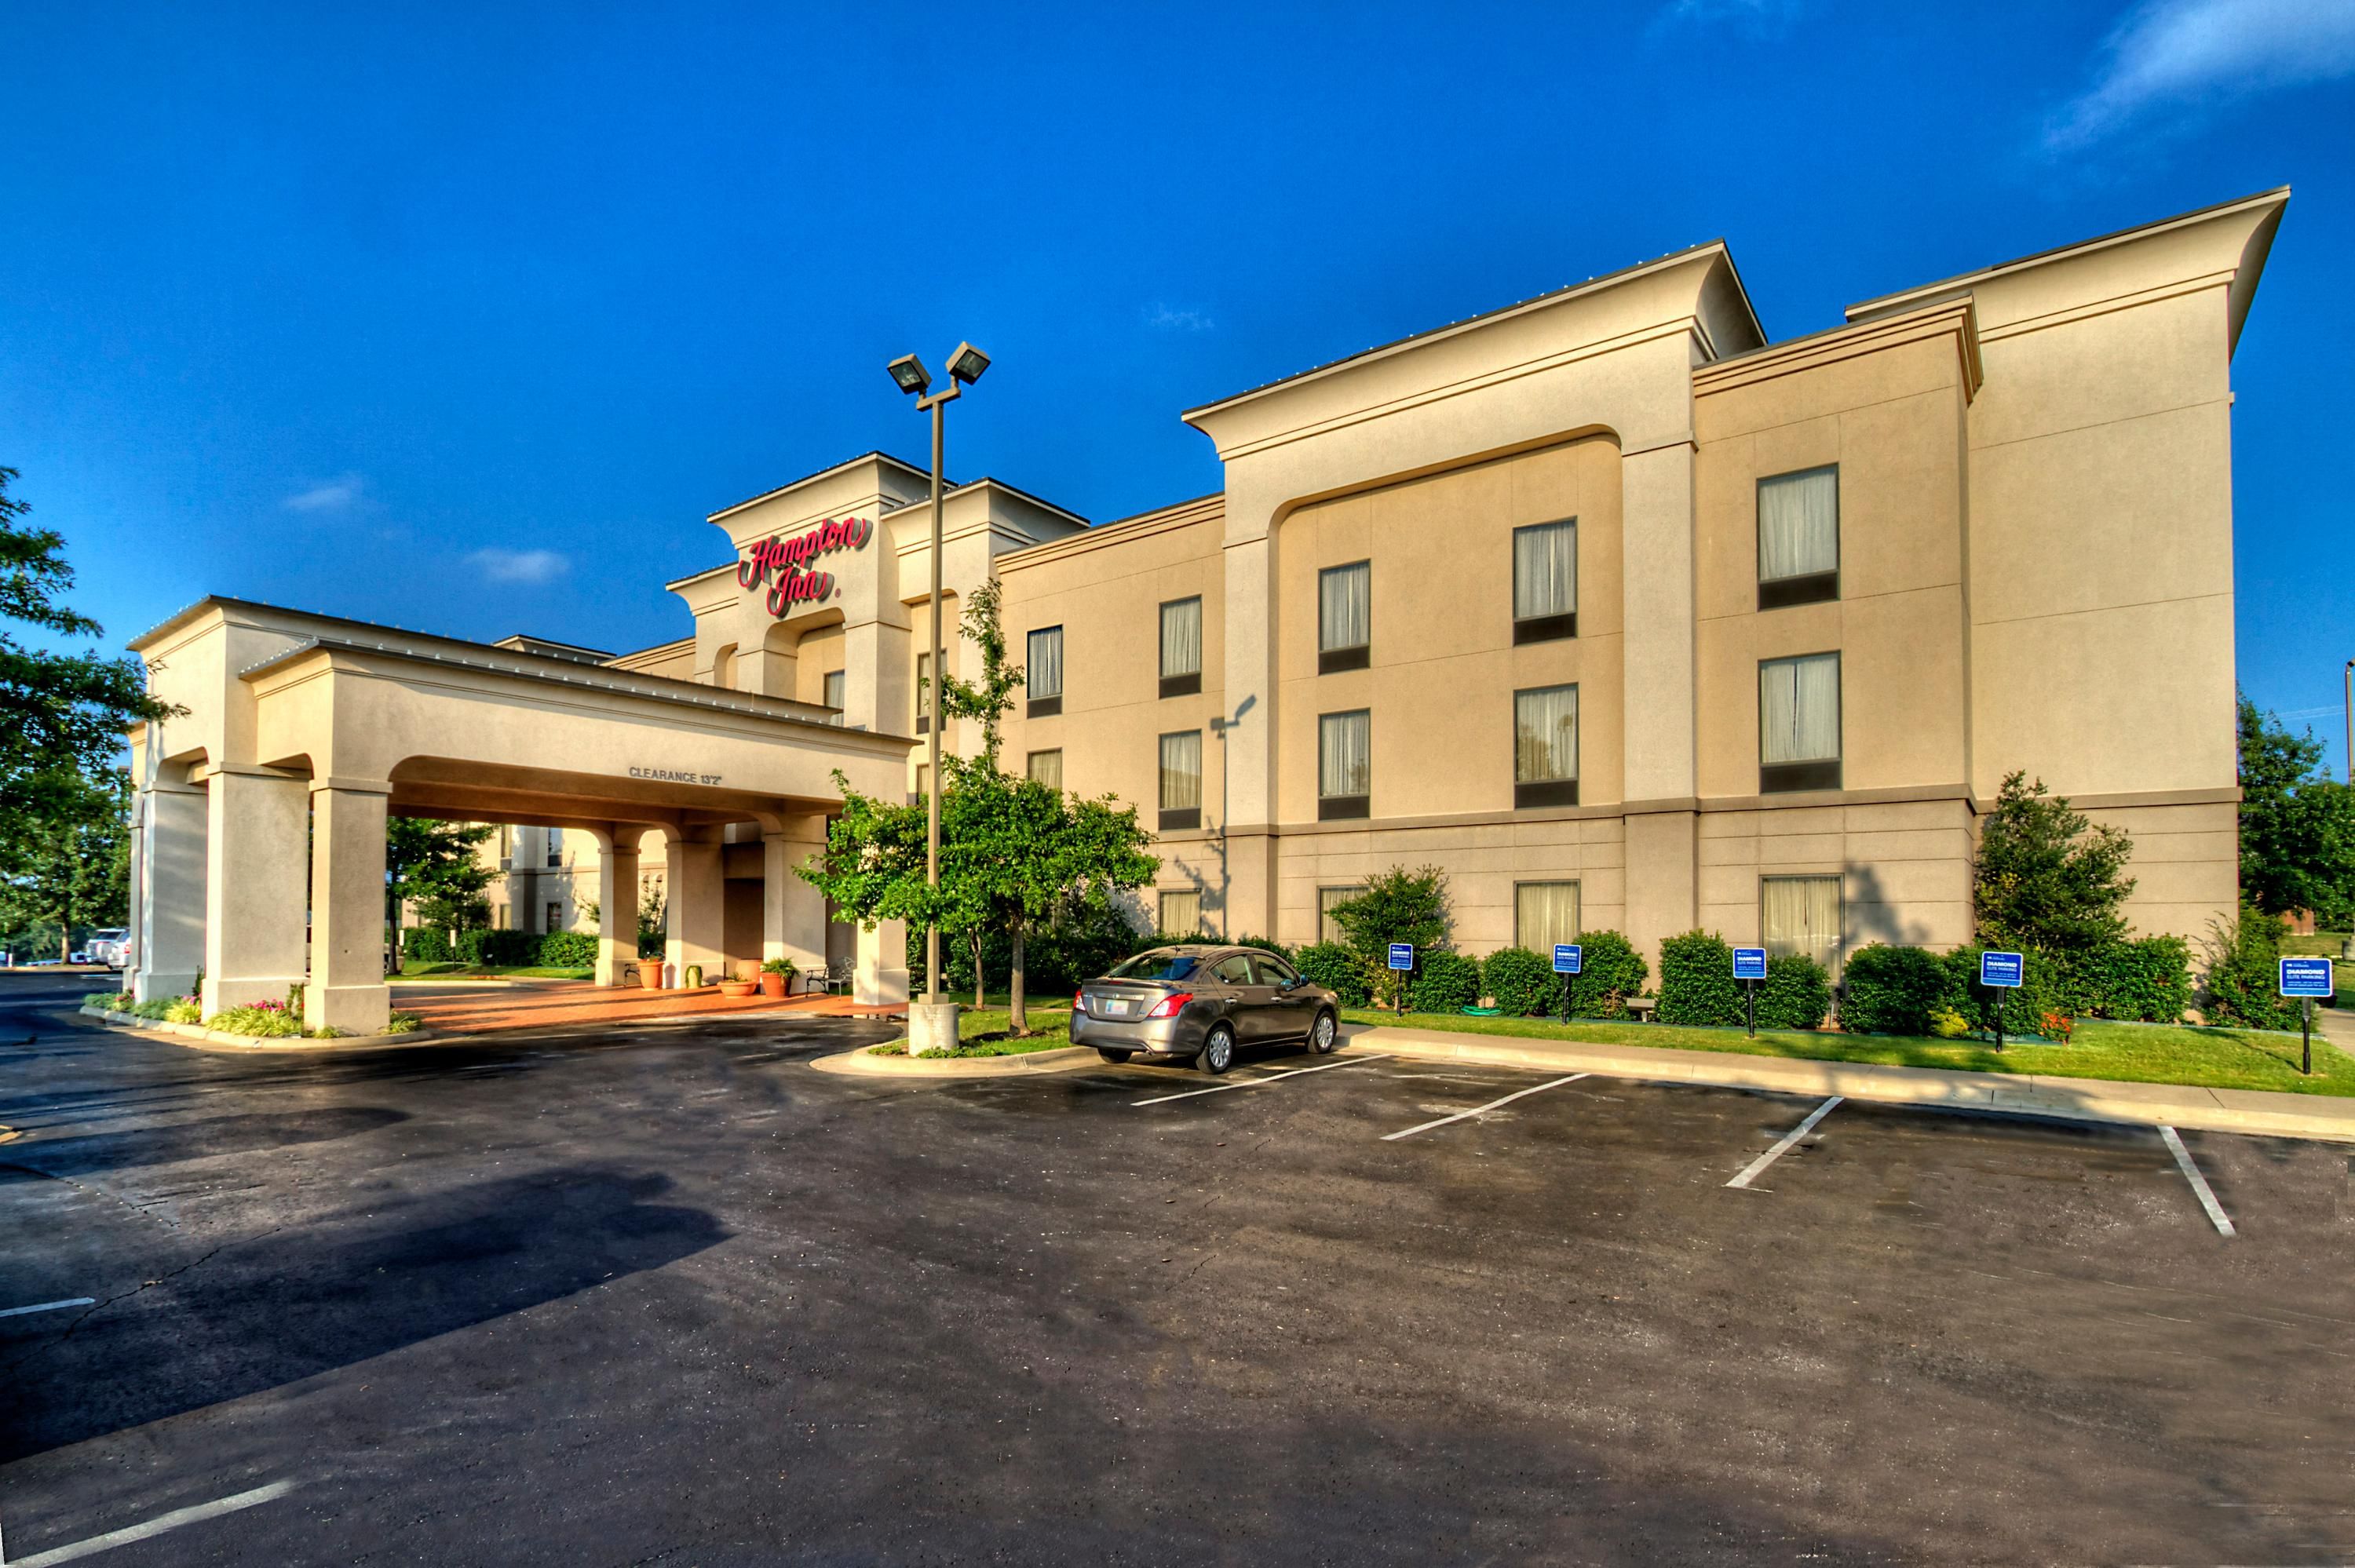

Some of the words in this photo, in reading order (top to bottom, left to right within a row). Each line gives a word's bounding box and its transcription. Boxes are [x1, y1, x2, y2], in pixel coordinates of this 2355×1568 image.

[738, 517, 871, 589] Hampton
[767, 566, 833, 618] Inn
[629, 767, 697, 783] CLEARANCE
